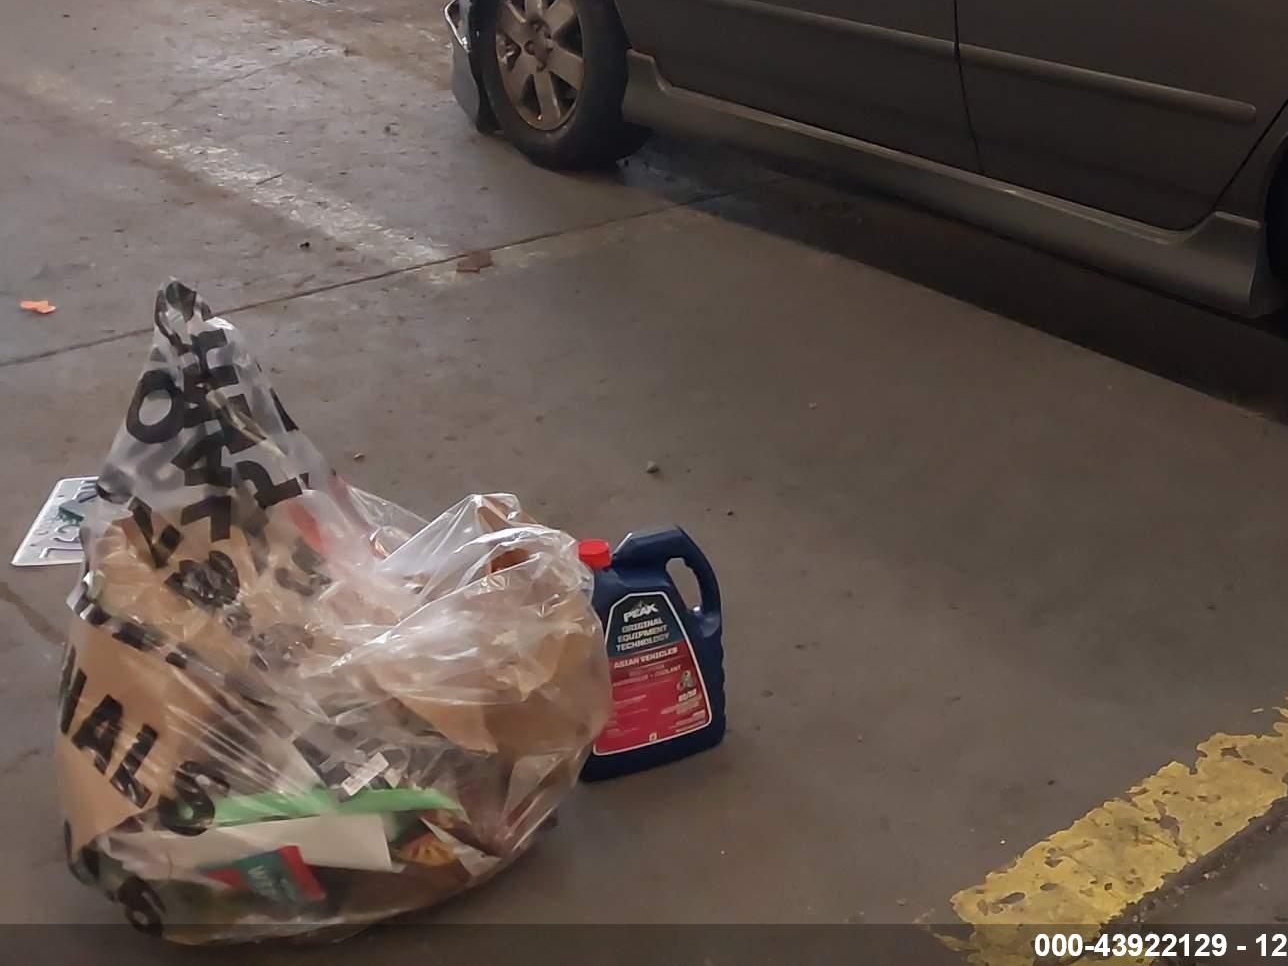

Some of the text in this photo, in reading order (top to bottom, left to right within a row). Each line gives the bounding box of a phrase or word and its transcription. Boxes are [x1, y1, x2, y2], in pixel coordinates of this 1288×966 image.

[623, 604, 658, 622] PEAK
[617, 624, 668, 642] EQUIPMENT
[622, 617, 663, 633] ORIGINAL
[615, 632, 670, 652] TECHNOLOGY
[614, 646, 678, 669] ASIAN VEHICLES
